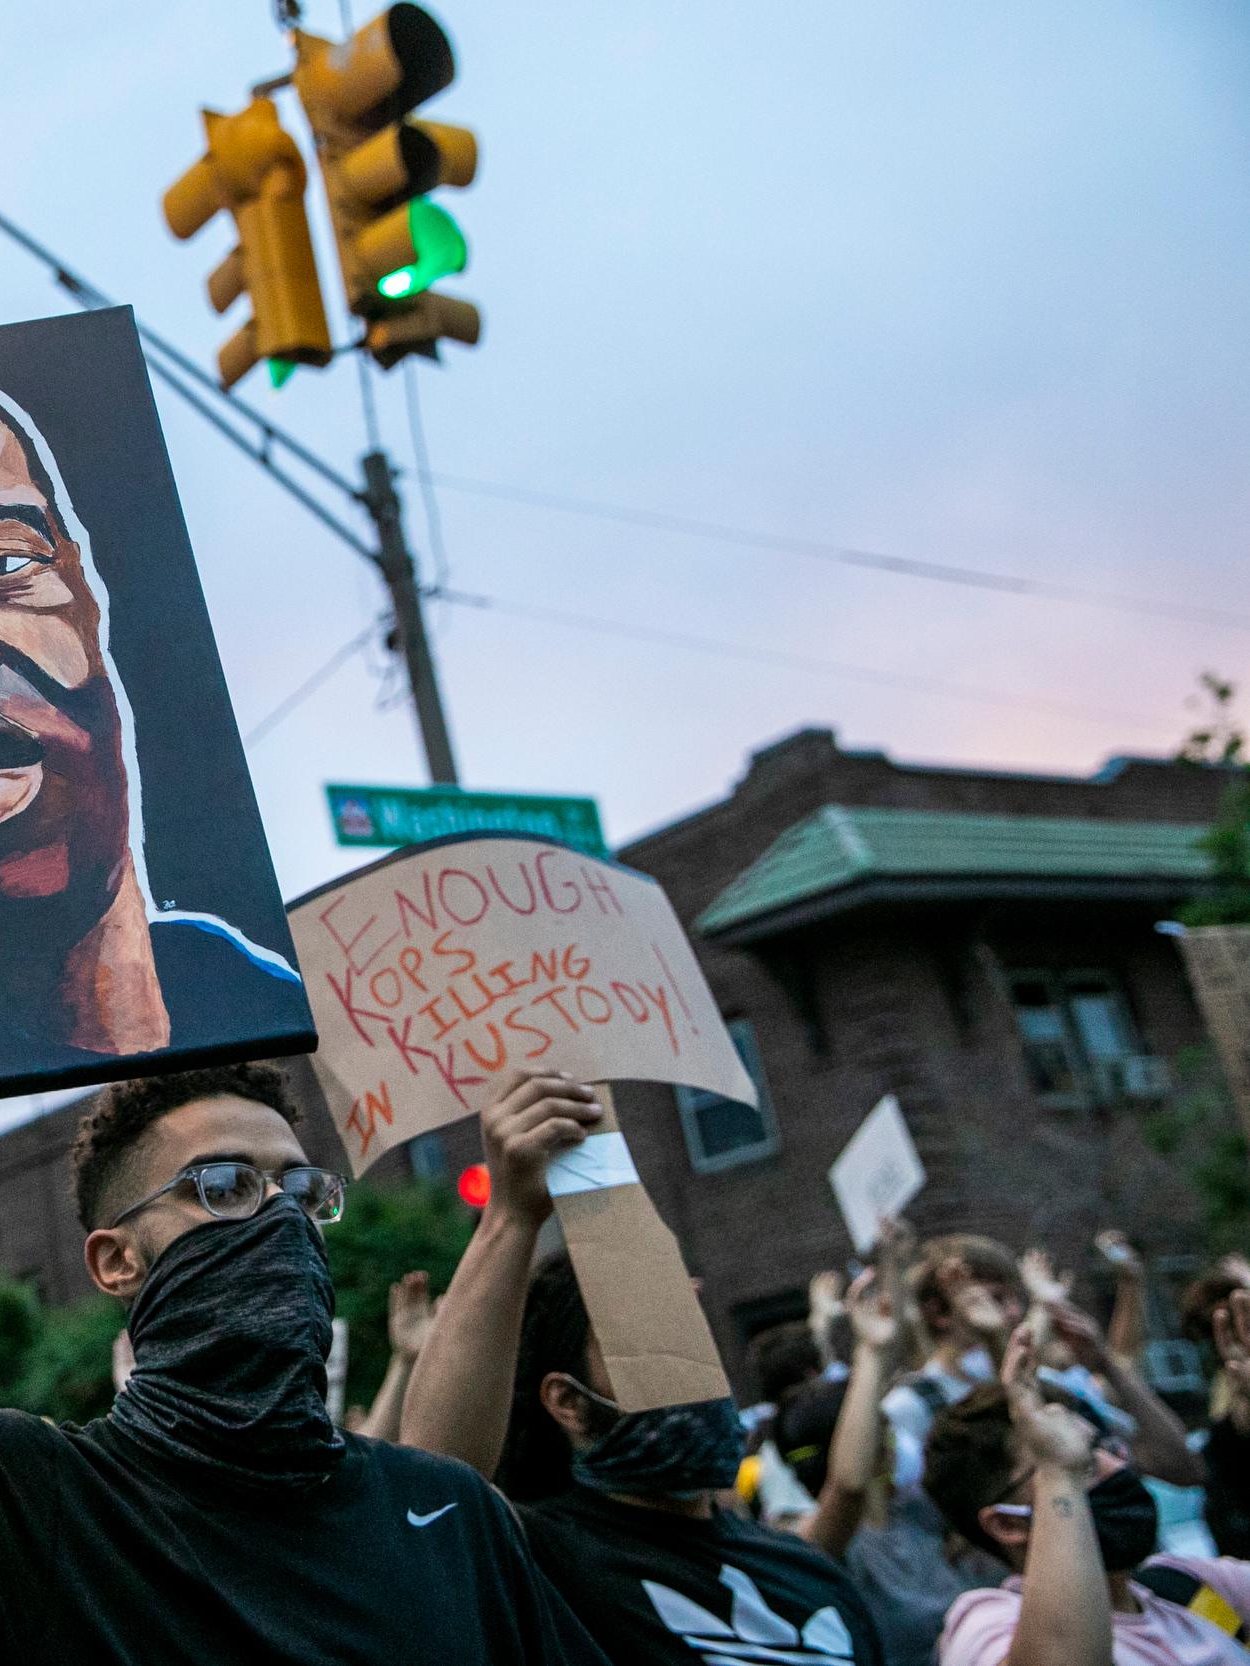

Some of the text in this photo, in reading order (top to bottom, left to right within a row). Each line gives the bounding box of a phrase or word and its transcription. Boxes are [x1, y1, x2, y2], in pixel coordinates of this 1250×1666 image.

[319, 850, 625, 976] ENOUGH
[326, 930, 477, 1048] KOPS
[387, 943, 591, 1076] KILLING
[345, 1080, 395, 1157] IN
